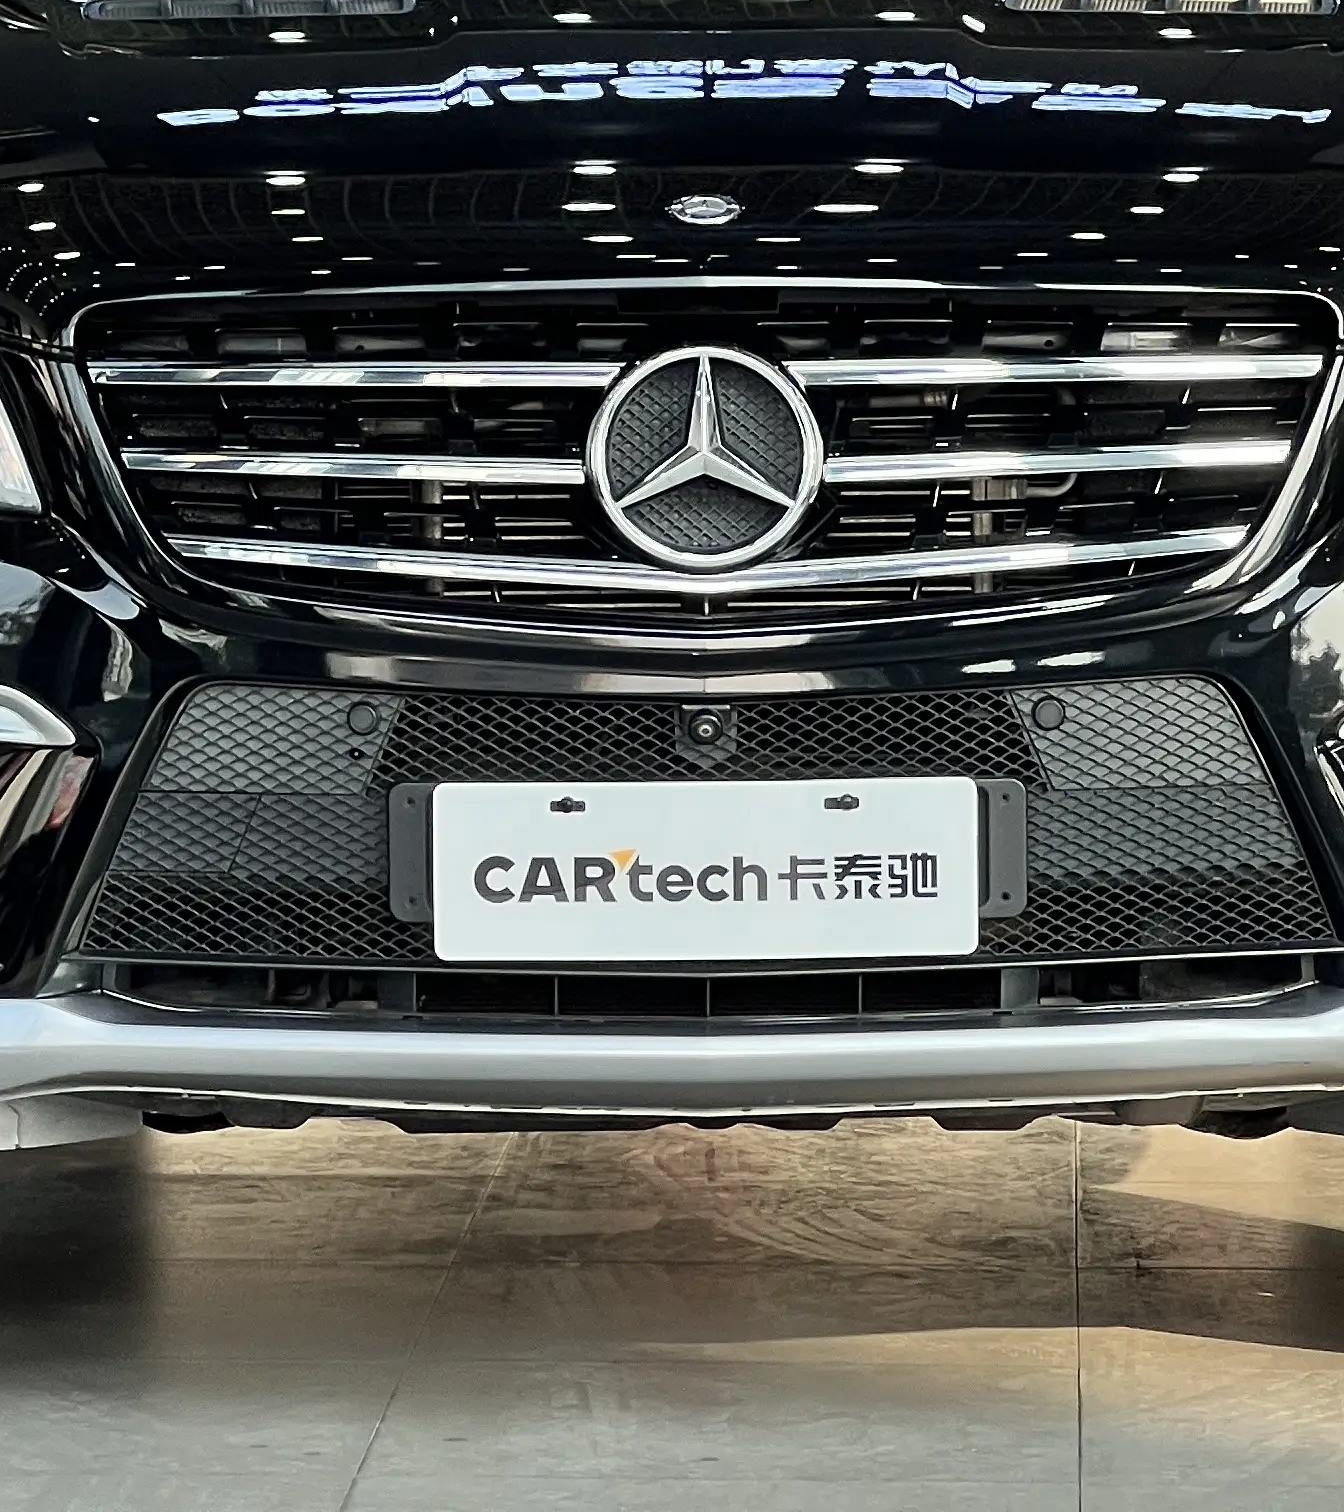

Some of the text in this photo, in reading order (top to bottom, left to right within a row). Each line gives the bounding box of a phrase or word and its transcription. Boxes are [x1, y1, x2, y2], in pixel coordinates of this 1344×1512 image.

[473, 852, 939, 904] CARtech 卡泰驰
